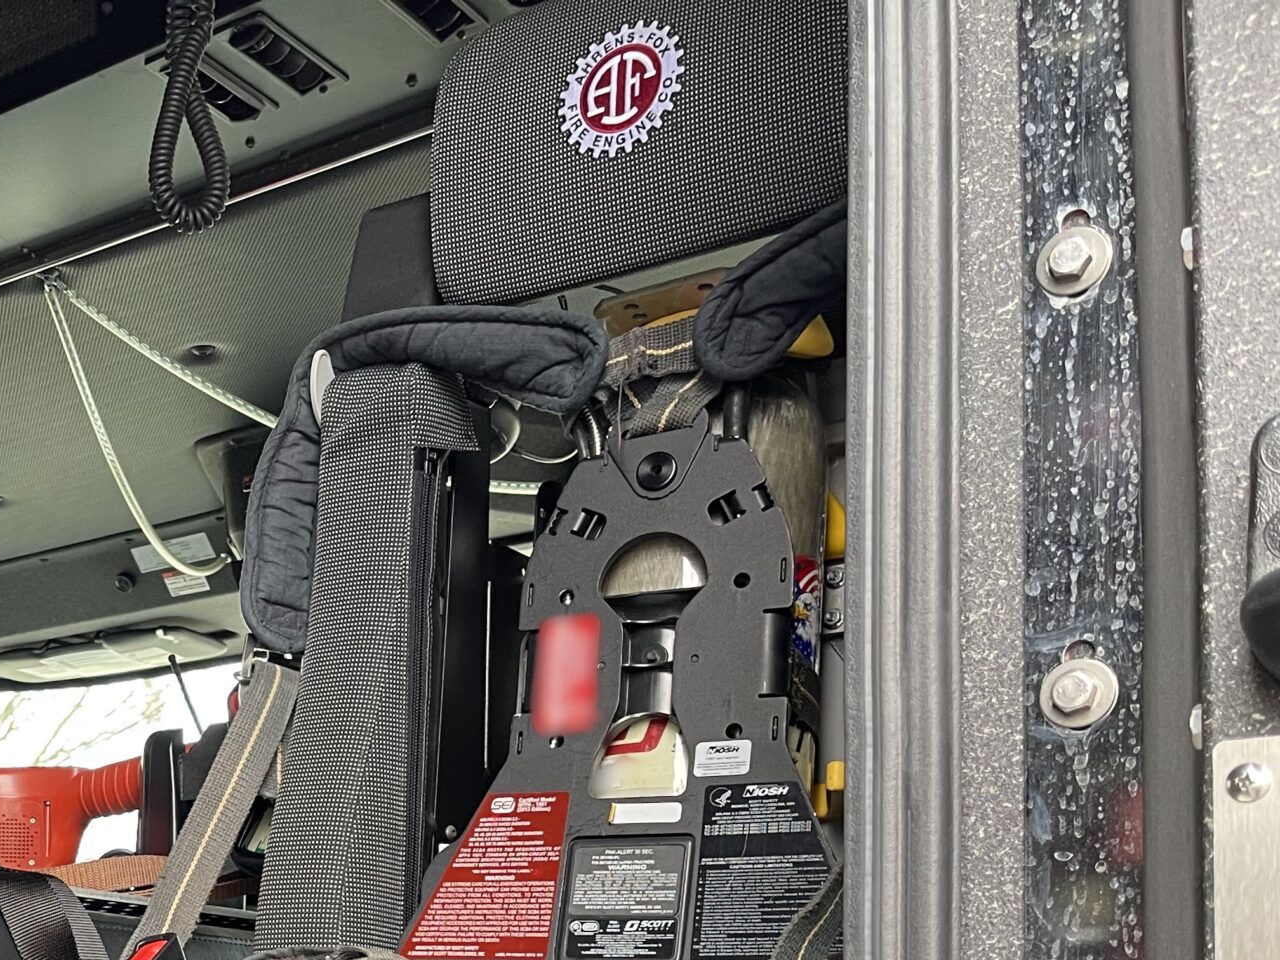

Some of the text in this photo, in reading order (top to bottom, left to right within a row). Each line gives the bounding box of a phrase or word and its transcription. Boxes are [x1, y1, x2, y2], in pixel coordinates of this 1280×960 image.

[567, 104, 590, 140] FIRE
[592, 111, 657, 147] ENGINE
[707, 745, 740, 754] NIOSH
[743, 784, 789, 797] NIOSH
